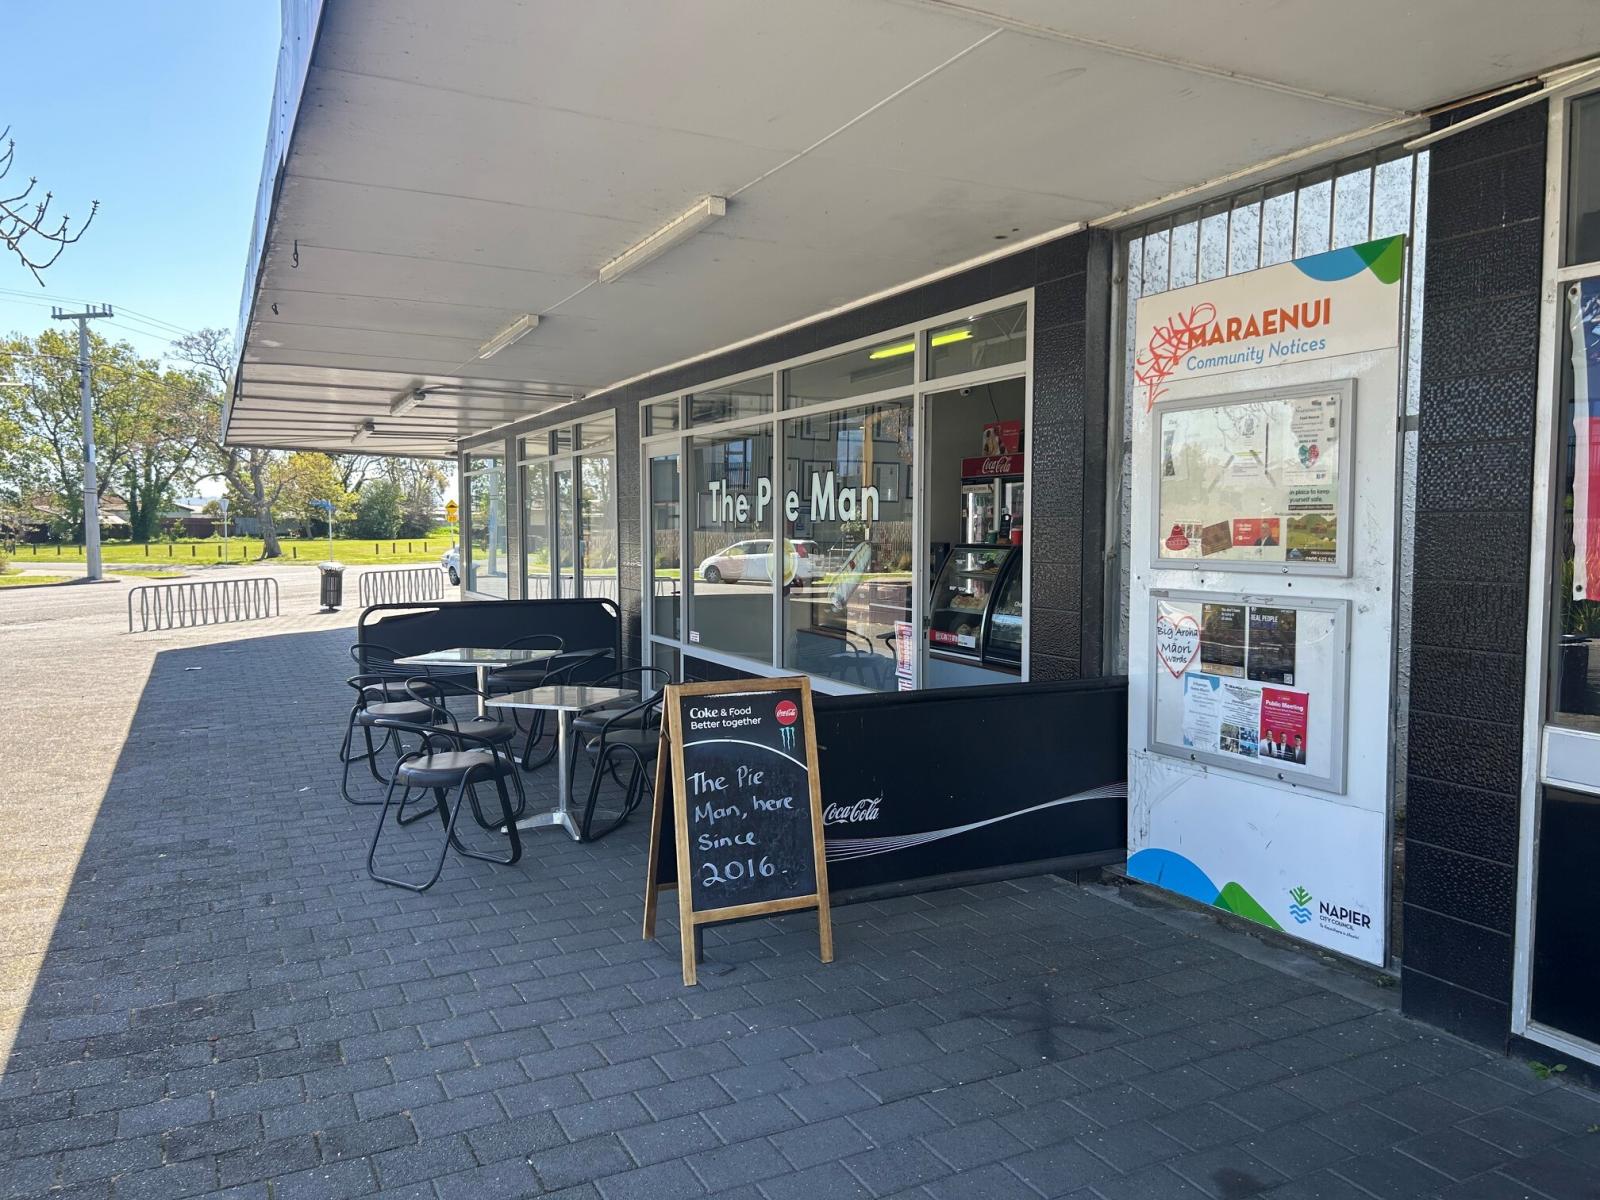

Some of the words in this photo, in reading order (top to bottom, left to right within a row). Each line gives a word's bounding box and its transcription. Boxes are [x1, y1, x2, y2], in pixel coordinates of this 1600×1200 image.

[1187, 298, 1330, 350] MARAENUI
[1187, 347, 1263, 371] Community
[1269, 338, 1325, 358] Notices
[982, 456, 1011, 474] Coca-Cola
[709, 479, 748, 522] The
[757, 477, 799, 521] Pe
[811, 471, 879, 521] Man
[1157, 625, 1173, 639] Big
[690, 707, 718, 719] Coke
[720, 708, 727, 717] &
[729, 706, 752, 716] Food
[1265, 699, 1281, 708] Public
[1282, 702, 1304, 712] Meeting
[691, 720, 720, 730] Better
[722, 717, 762, 728] together
[687, 771, 729, 795] The
[736, 765, 764, 787] Pie
[695, 801, 748, 825] Man,
[752, 795, 793, 811] here
[823, 796, 883, 826] Coca-Cola
[1319, 900, 1371, 929] NAPIER
[1320, 915, 1331, 923] CITY
[1332, 918, 1355, 931] COUNCIL
